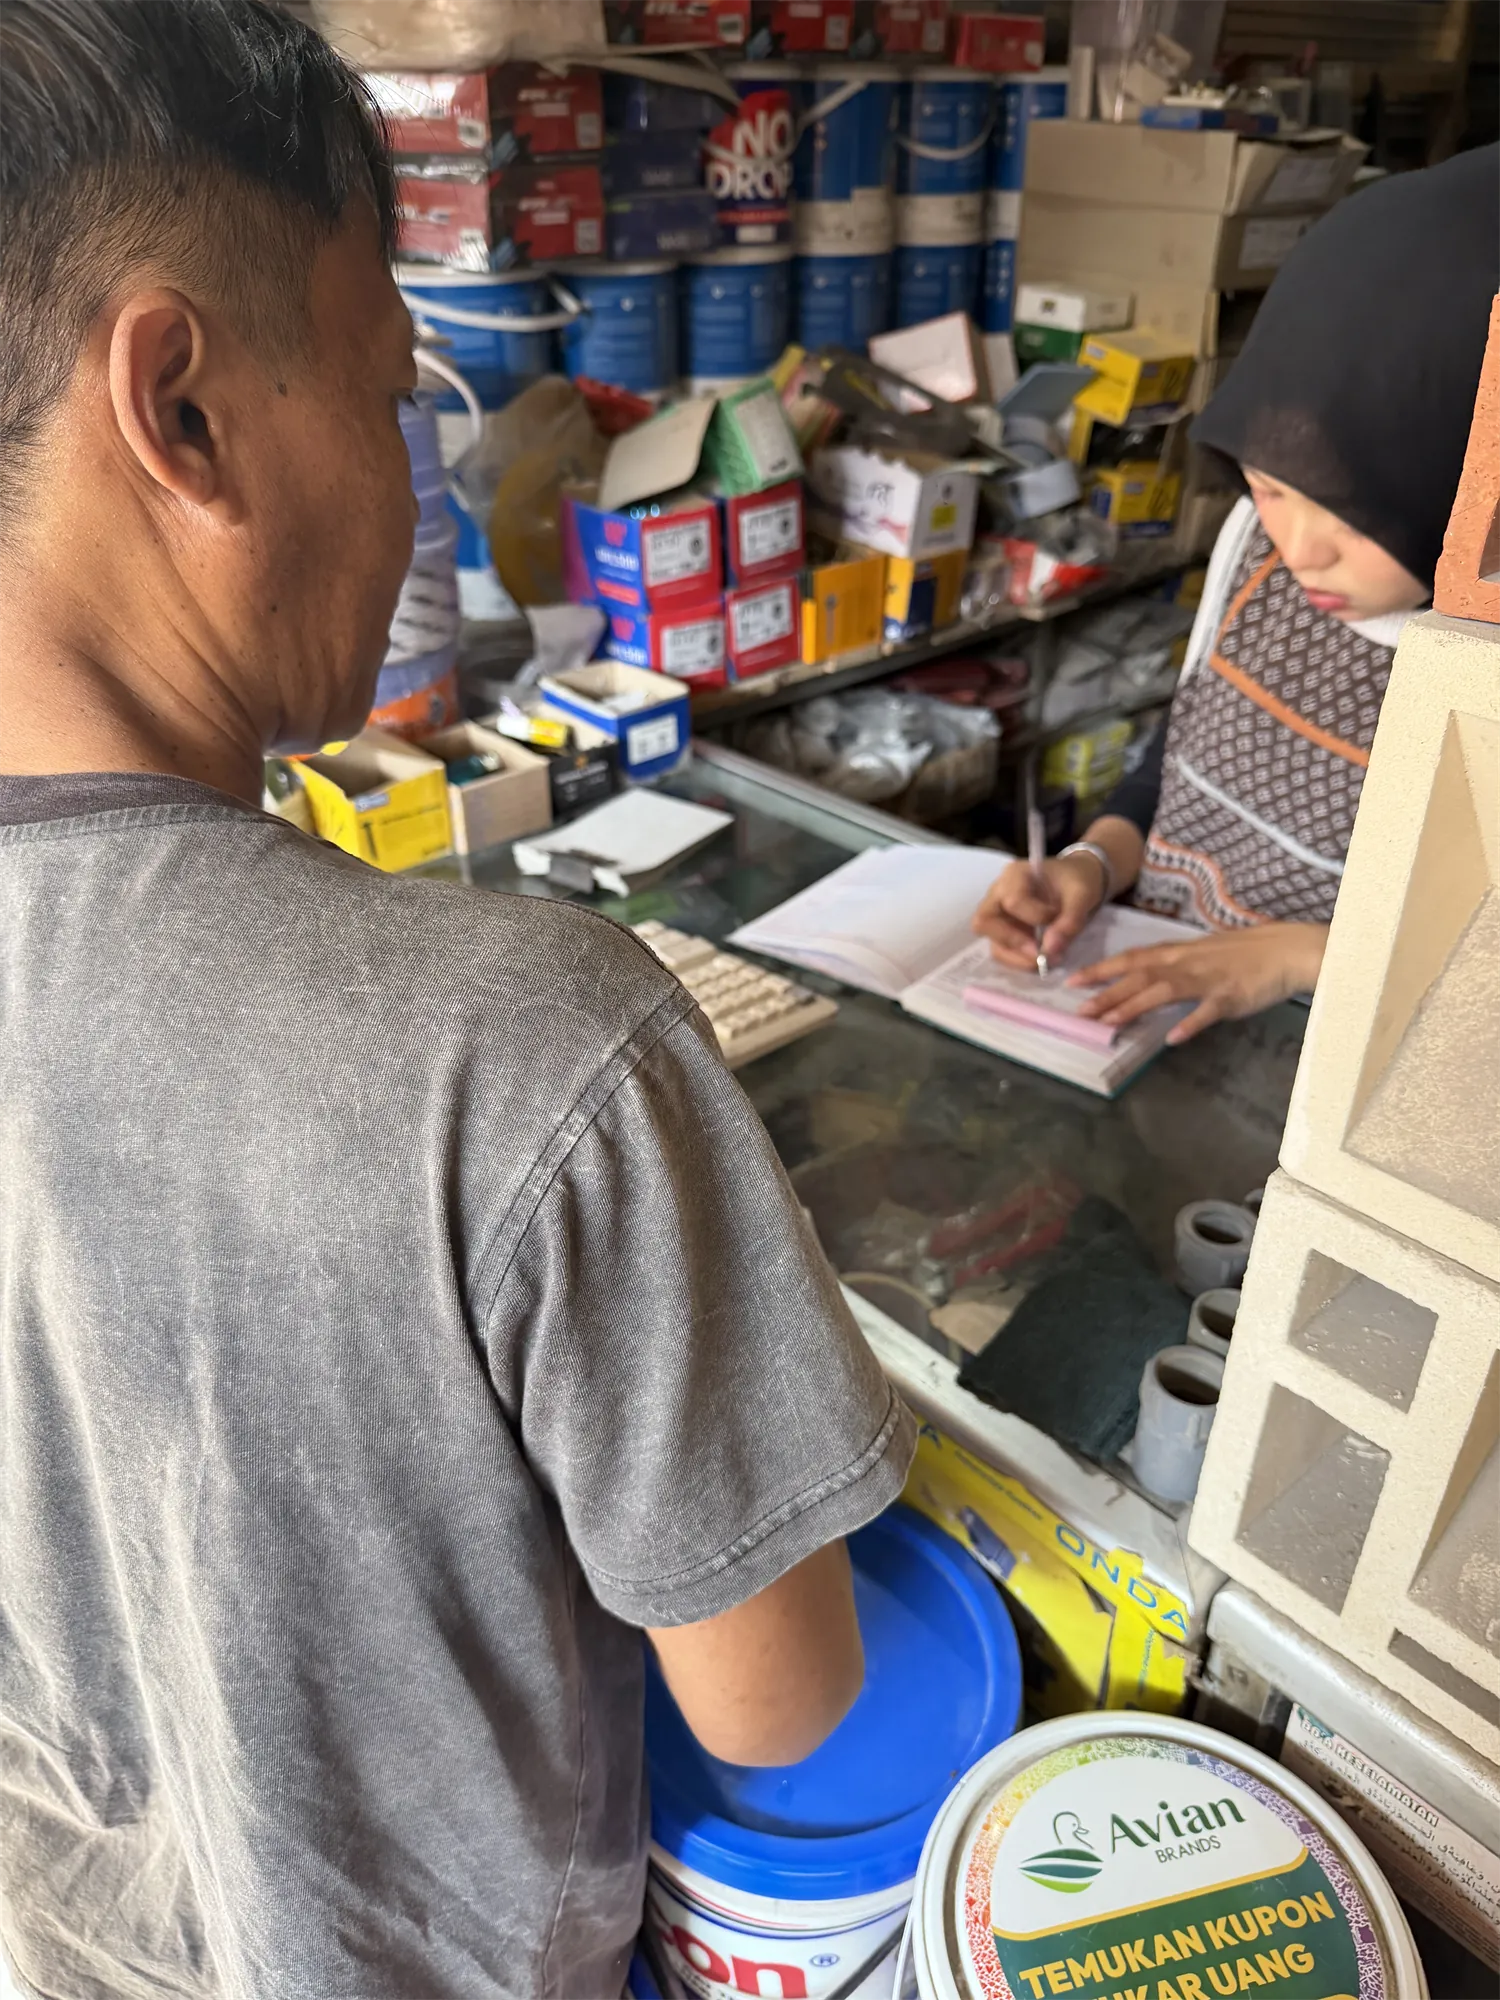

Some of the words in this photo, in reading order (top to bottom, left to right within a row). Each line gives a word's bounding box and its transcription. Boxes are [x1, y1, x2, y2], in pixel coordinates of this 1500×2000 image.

[732, 109, 794, 158] NO
[1055, 1523, 1189, 1635] ONDA
[1334, 1741, 1440, 1828] KESELAMATAN
[1110, 1797, 1247, 1855] Avian
[1155, 1835, 1222, 1865] BRANDS
[660, 1924, 808, 1999] on
[1019, 1924, 1208, 2000] TEMUKAN
[1203, 1891, 1336, 1950] KUPON
[1206, 1943, 1316, 1997] UANG
